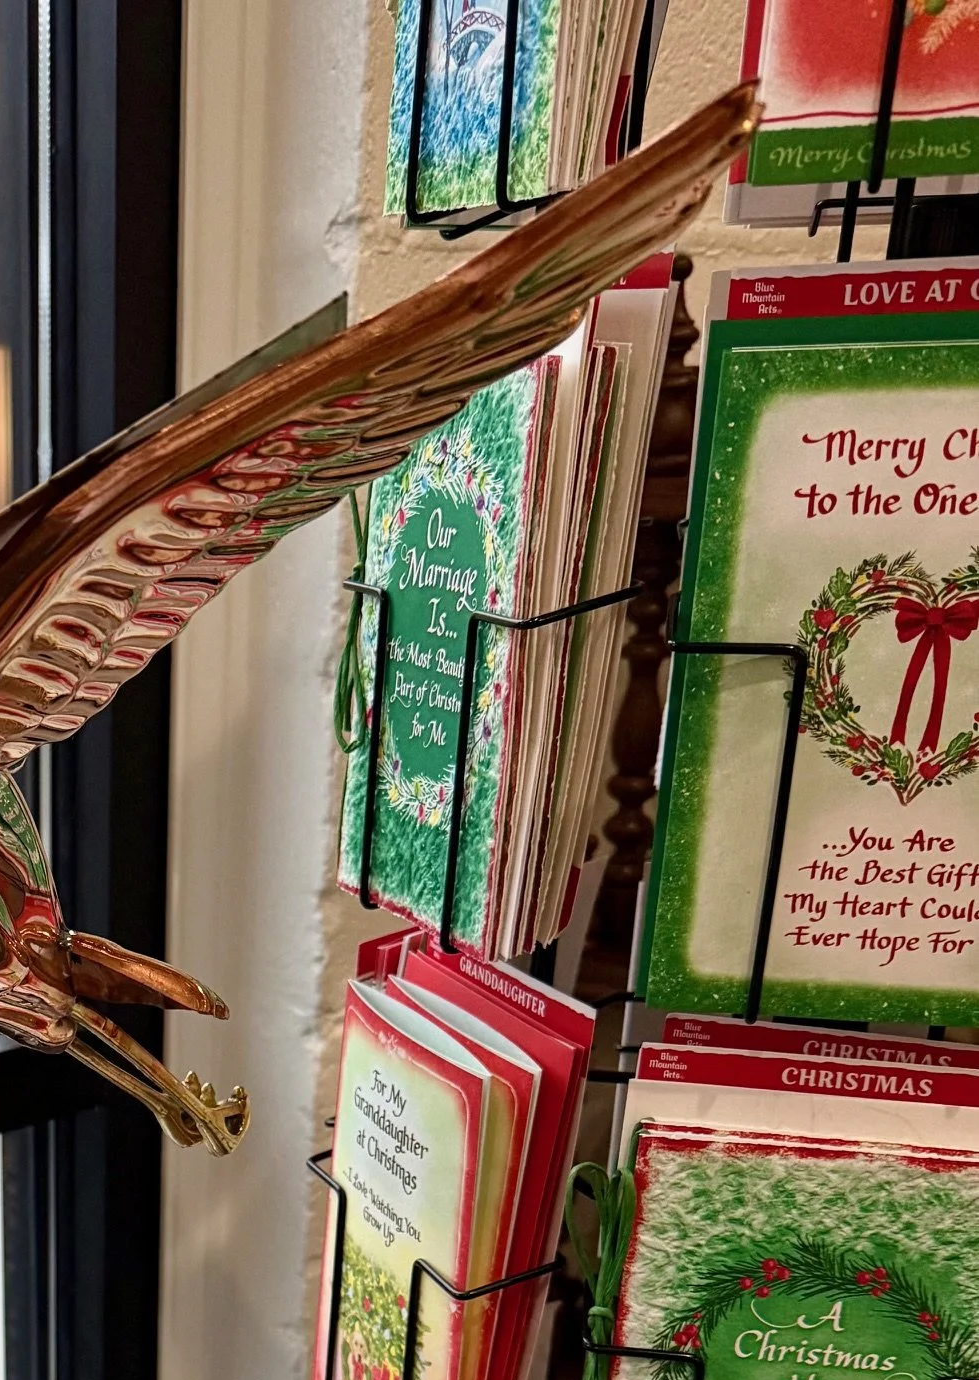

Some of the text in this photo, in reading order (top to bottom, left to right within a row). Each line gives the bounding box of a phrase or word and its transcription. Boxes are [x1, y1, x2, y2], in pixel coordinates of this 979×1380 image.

[769, 137, 972, 173] Merry Cristmas
[742, 293, 786, 303] Mountain
[755, 282, 775, 292] Blue
[844, 280, 915, 306] LOVE
[925, 279, 962, 302] AT
[802, 428, 926, 479] Merry
[794, 483, 979, 519] to the One
[426, 507, 458, 549] Our
[399, 544, 478, 612] Marriage
[387, 635, 405, 662] the
[406, 641, 433, 669] Most
[390, 670, 416, 708] Part
[416, 680, 428, 706] of
[409, 712, 447, 748] for Me
[902, 829, 956, 852] Are
[798, 859, 849, 882] the
[854, 860, 923, 885] Best
[784, 893, 827, 922] My
[833, 892, 914, 918] Heart
[784, 925, 975, 967] Ever Hope For
[459, 955, 546, 1018] GRANDDAUGHTER
[673, 1030, 710, 1041] Mountain
[684, 1022, 702, 1033] Blue
[649, 1060, 688, 1071] Mountain
[660, 1052, 678, 1063] Blue
[370, 1069, 407, 1117] For My
[781, 1067, 933, 1097] CHRISTMAS
[354, 1086, 429, 1159] Granddaughter
[356, 1129, 417, 1195] at Christmas
[353, 1173, 368, 1198] Love
[369, 1188, 404, 1233] Watching
[404, 1217, 421, 1243] You
[363, 1206, 395, 1247] Grow Up
[772, 1300, 845, 1331] A
[734, 1329, 897, 1371] Christmas
